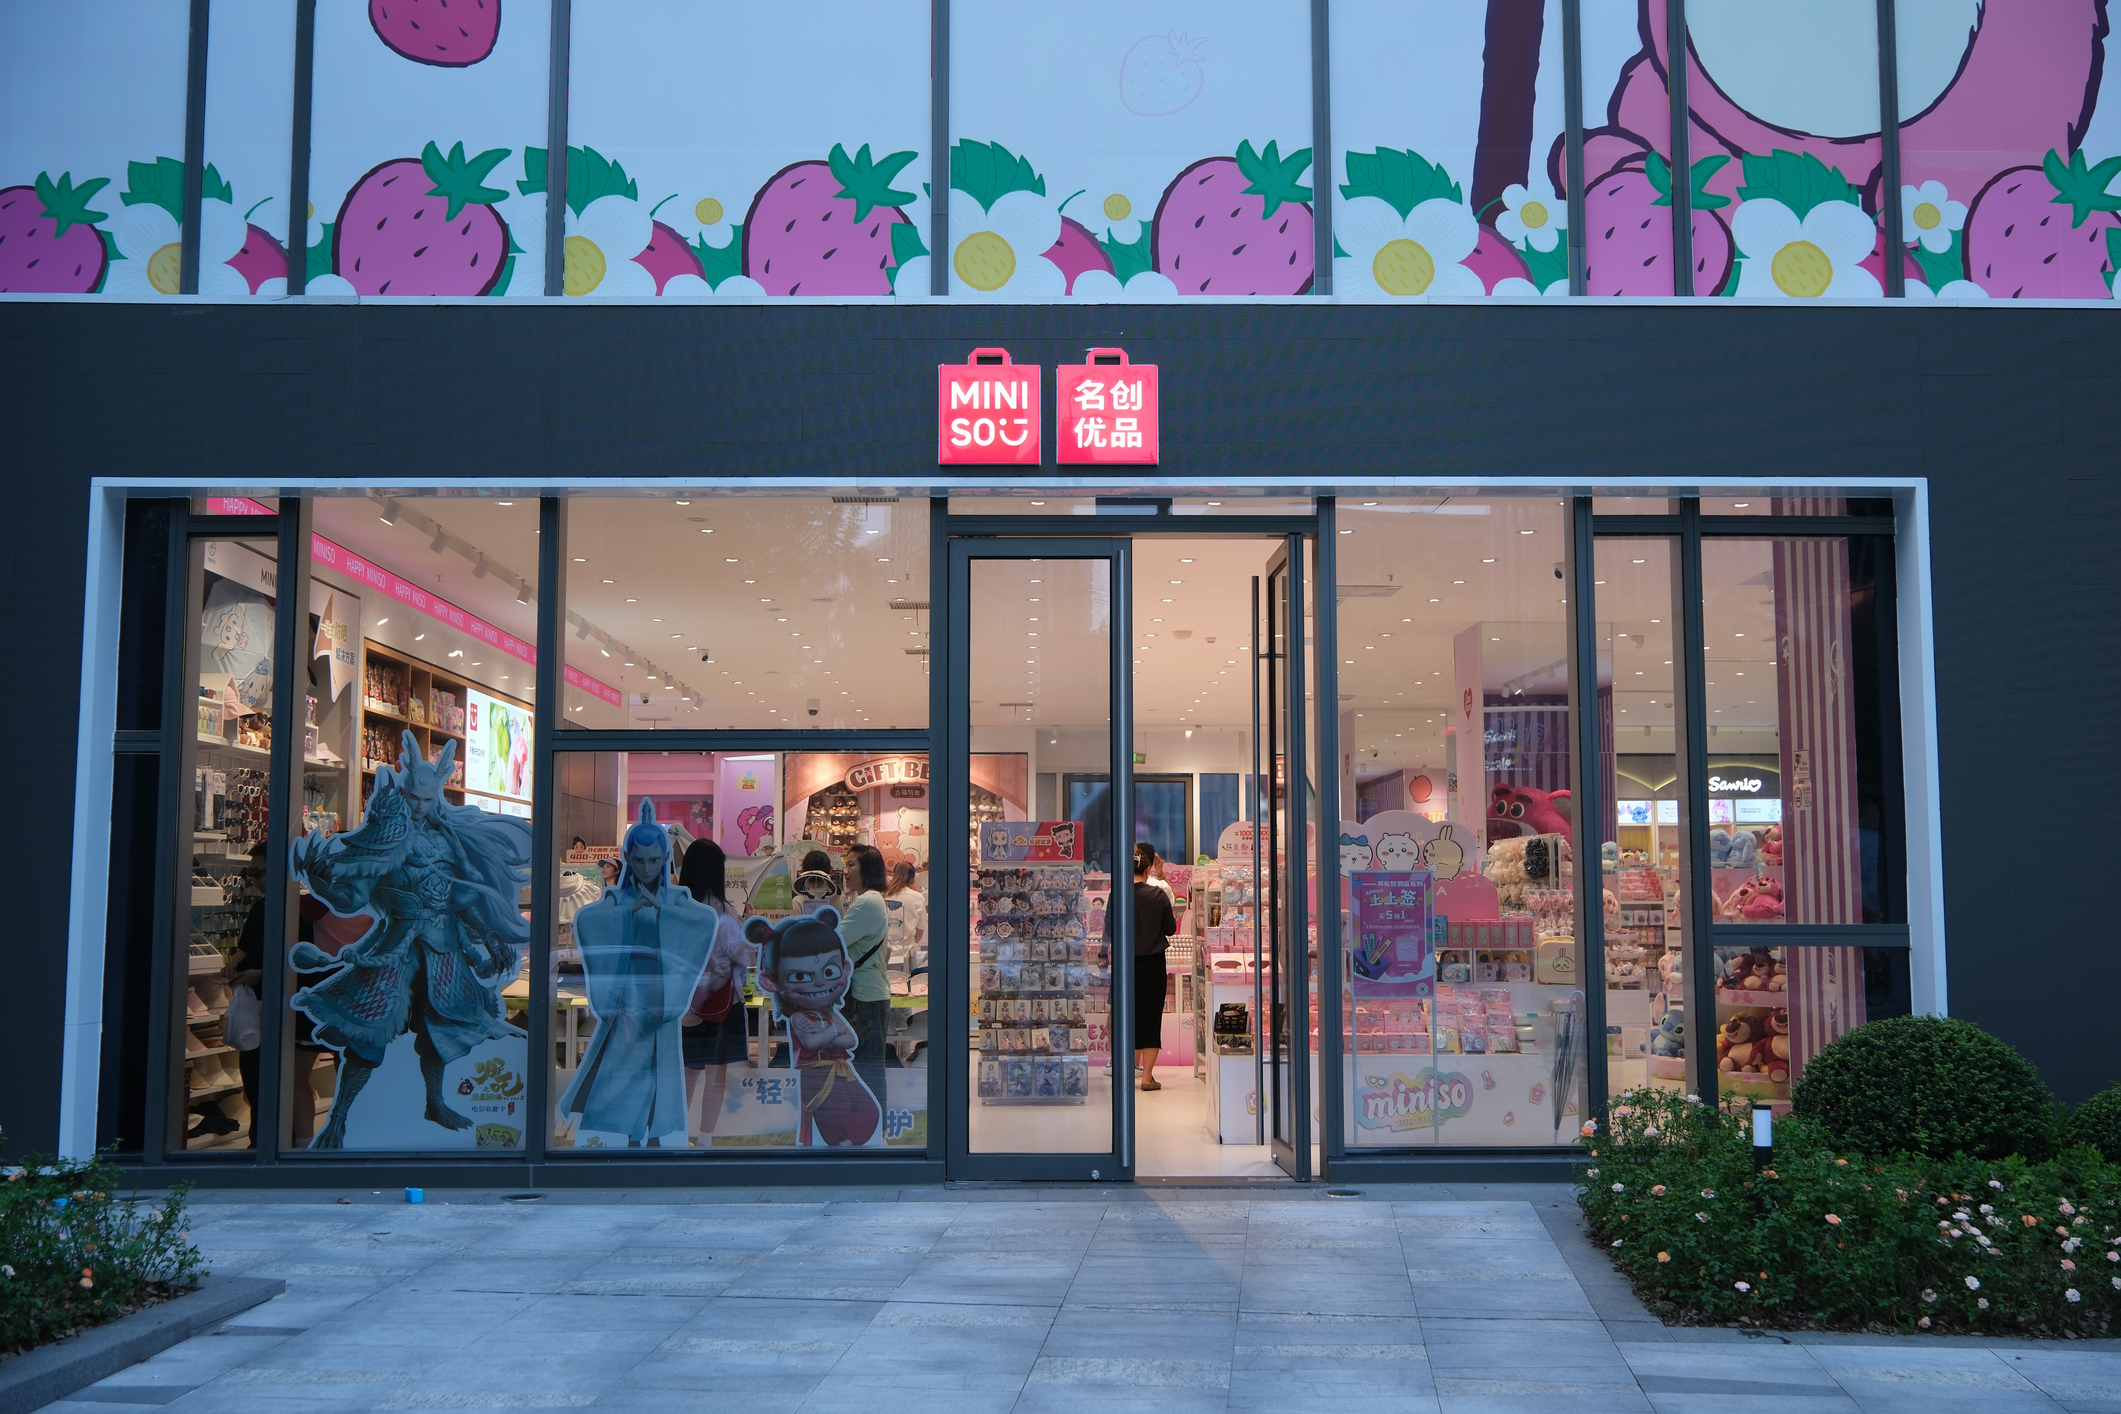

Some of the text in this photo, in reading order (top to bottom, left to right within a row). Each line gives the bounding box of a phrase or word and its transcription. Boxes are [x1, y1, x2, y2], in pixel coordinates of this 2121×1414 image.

[951, 381, 1028, 410] MINI
[1074, 379, 1143, 411] 名创
[1074, 417, 1143, 448] 优品
[313, 539, 336, 563] MINISO
[346, 556, 386, 588] HAPPY MINISO
[395, 581, 412, 600] HAPPY
[433, 601, 448, 619] HAPPY
[849, 761, 898, 788] GIFT
[1370, 889, 1417, 907] 上上签
[1362, 1076, 1466, 1120] miniso
[886, 1110, 913, 1138] 护
[1395, 1119, 1408, 1127] LIFE
[1416, 1116, 1429, 1124] FOR
[1429, 1114, 1443, 1122] FN
